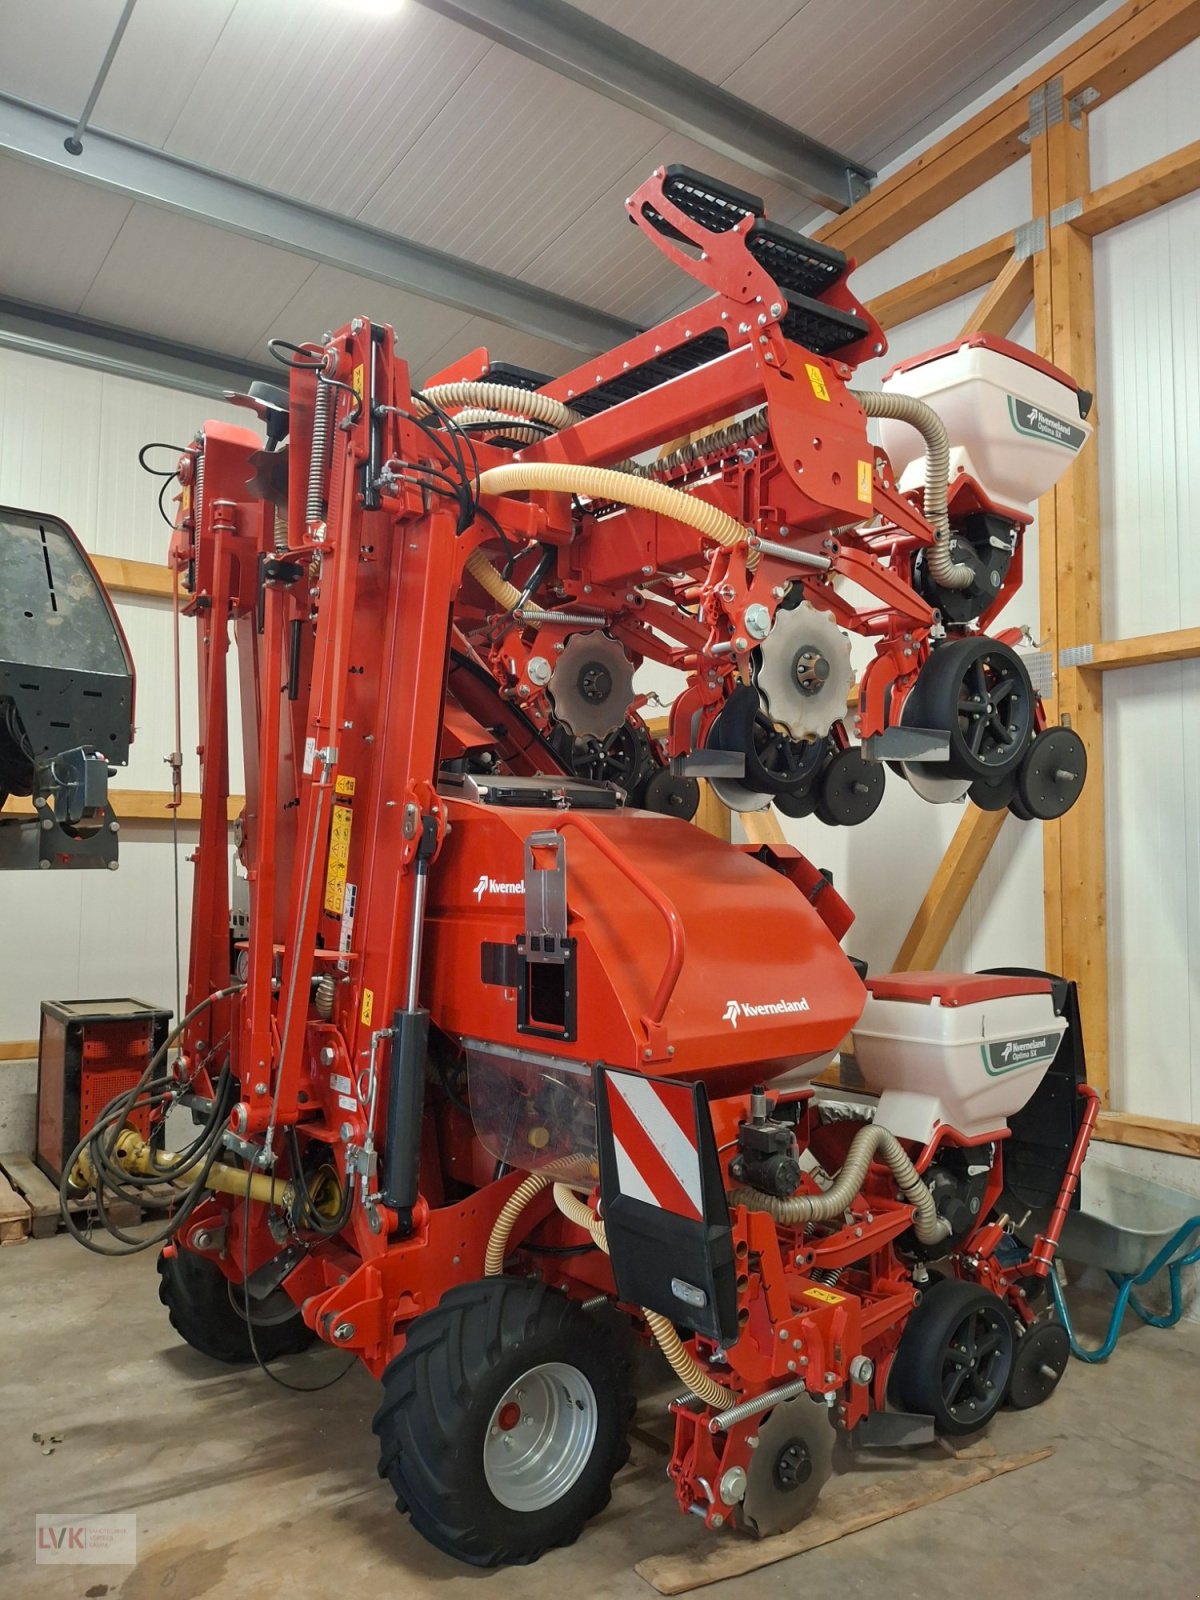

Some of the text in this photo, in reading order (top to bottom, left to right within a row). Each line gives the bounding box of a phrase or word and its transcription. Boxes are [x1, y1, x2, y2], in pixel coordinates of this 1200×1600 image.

[1037, 422, 1055, 436] Optima
[1038, 411, 1071, 436] Kverneland
[489, 879, 526, 894] Kvernel
[740, 997, 810, 1017] Kverneland
[1013, 1037, 1046, 1052] Kverneland
